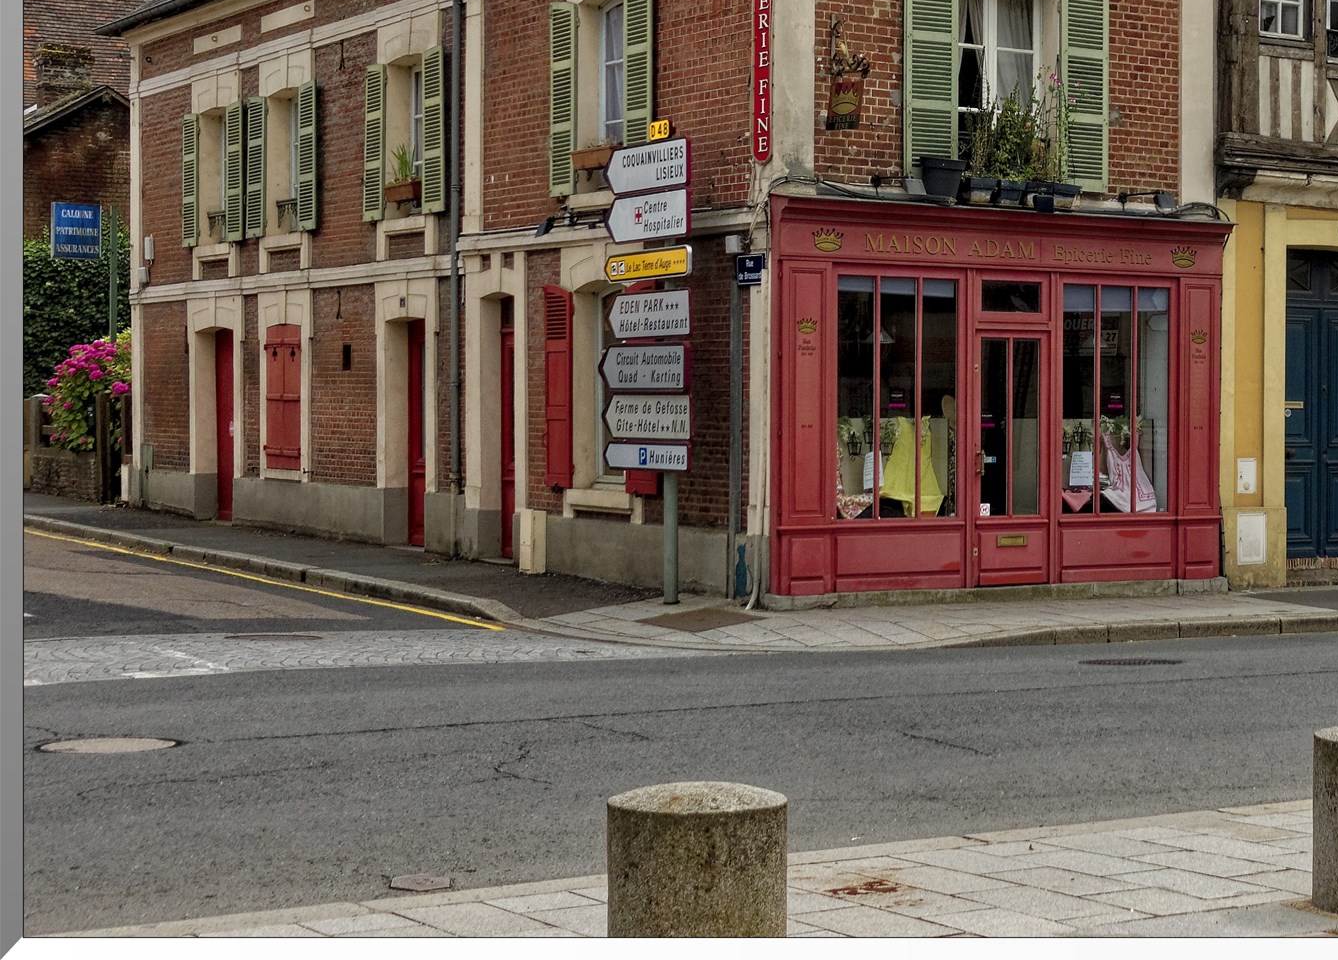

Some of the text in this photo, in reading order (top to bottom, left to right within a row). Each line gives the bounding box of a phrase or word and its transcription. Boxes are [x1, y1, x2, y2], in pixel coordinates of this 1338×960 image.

[757, 79, 769, 153] FINE
[650, 123, 668, 137] D 48
[622, 146, 684, 168] COQUAINVILLIERS
[656, 165, 684, 181] LISIEUX
[643, 200, 667, 214] Centre
[56, 226, 99, 237] PATRIMOINE
[643, 217, 684, 234] Hospitalier
[56, 244, 99, 254] ASSURANCES
[864, 233, 957, 256] MAISON
[968, 239, 1036, 259] ADAM
[1120, 248, 1152, 266] Fine
[633, 262, 641, 272] Lac
[642, 260, 654, 271] Terre
[655, 258, 672, 271] d'Auge
[745, 259, 754, 268] Rue
[738, 272, 744, 280] de
[619, 298, 664, 314] EDEN PARK
[619, 317, 688, 333] Hôtel-Restaurant
[616, 351, 681, 366] Circuit Automobile
[618, 370, 638, 383] Quad
[650, 370, 681, 386] Karting
[615, 401, 688, 415] Ferme de Gefosse
[671, 419, 688, 434] N.N.
[649, 450, 686, 465] Hunières
